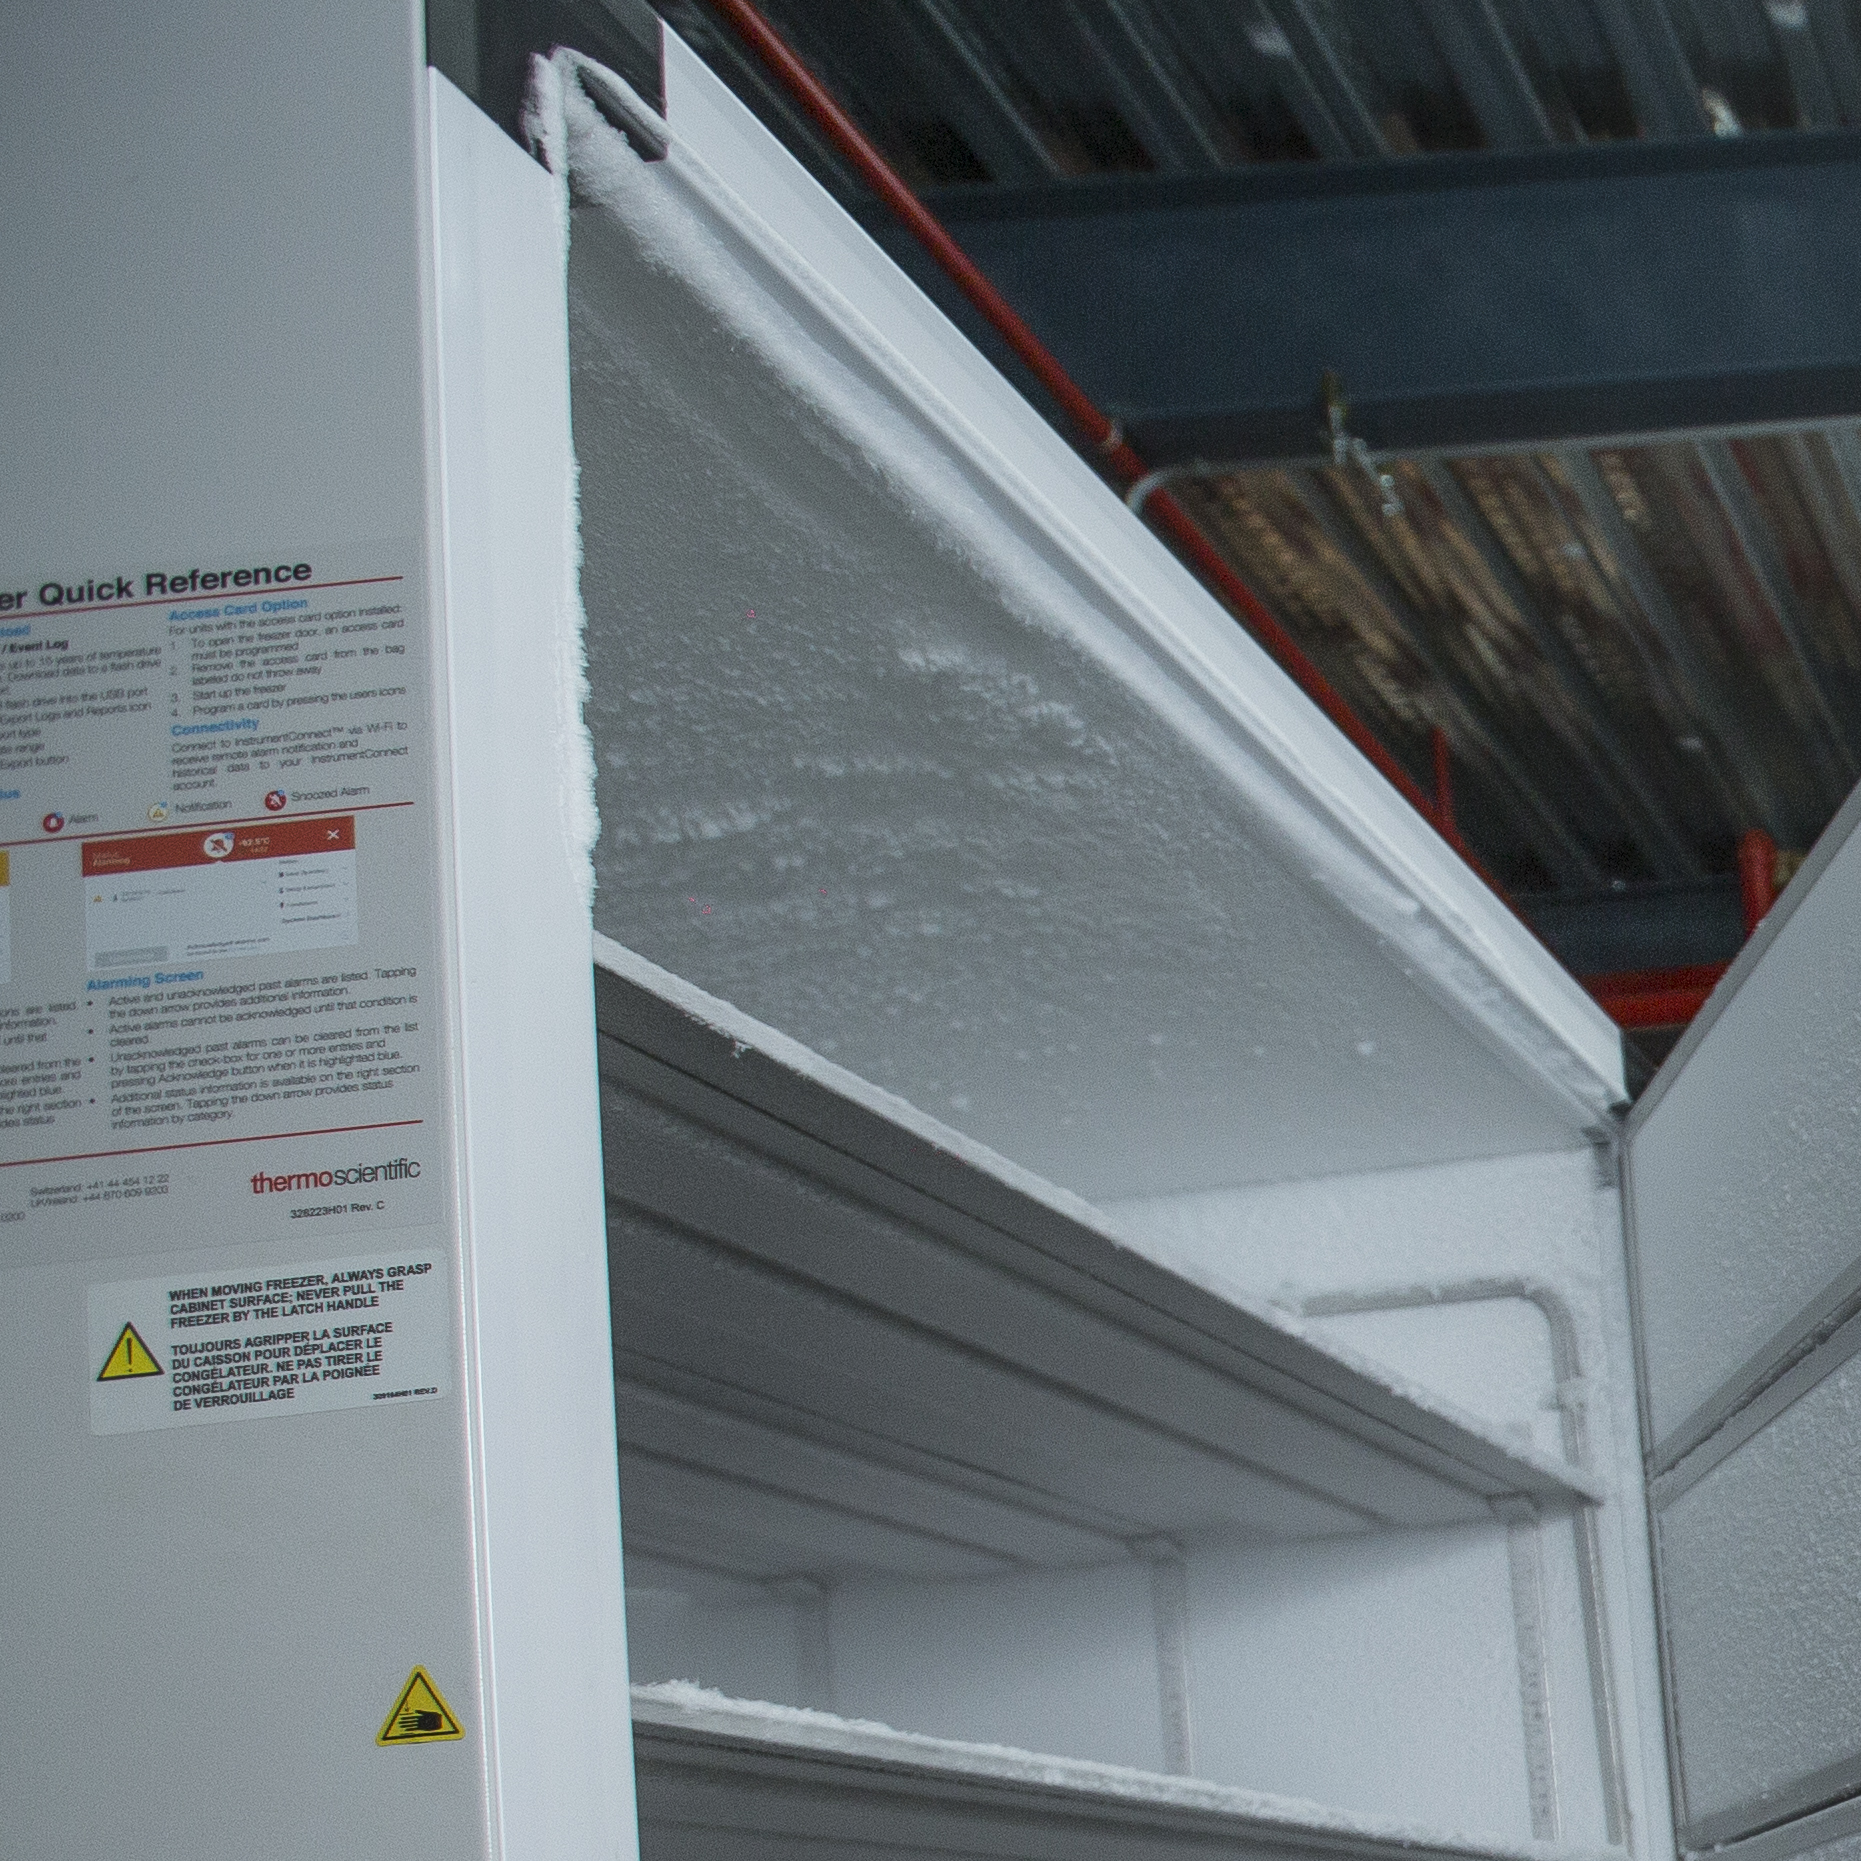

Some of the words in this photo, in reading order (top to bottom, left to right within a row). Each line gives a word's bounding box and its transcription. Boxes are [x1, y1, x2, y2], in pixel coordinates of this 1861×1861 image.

[38, 577, 133, 606] Quick
[144, 563, 312, 594] Reference
[168, 608, 220, 621] Access
[223, 604, 257, 616] Card
[261, 600, 308, 612] Option
[168, 625, 186, 636] For
[188, 623, 214, 634] units
[215, 621, 237, 631] with
[238, 619, 256, 629] the
[258, 616, 296, 627] access
[298, 613, 322, 623] card
[324, 610, 356, 620] option
[8, 642, 43, 653] Event
[46, 640, 69, 650] Log
[191, 637, 206, 648] To
[207, 637, 235, 648] open
[237, 634, 254, 643] the
[257, 631, 291, 641] freezer
[325, 626, 338, 635] an
[341, 623, 377, 633] access
[381, 619, 404, 629] card
[191, 650, 217, 660] must
[218, 649, 233, 658] be
[235, 643, 299, 657] programmed
[191, 662, 234, 673] Remove
[238, 659, 256, 668] the
[261, 656, 298, 666] access
[305, 652, 328, 662] card
[333, 649, 356, 658] from
[362, 647, 379, 655] the
[385, 645, 405, 654] bag
[191, 675, 229, 686] labeled
[231, 673, 245, 682] do
[246, 670, 263, 679] not
[265, 669, 293, 678] throw
[296, 666, 321, 675] away
[192, 690, 216, 701] Start
[218, 689, 233, 699] up
[234, 687, 251, 696] the
[253, 684, 286, 694] freezer
[192, 704, 236, 716] Program
[237, 703, 245, 711] a
[246, 699, 270, 710] card
[270, 698, 284, 708] by
[286, 695, 329, 707] pressing
[330, 692, 348, 701] the
[379, 687, 405, 696] icons
[170, 719, 259, 736] Connectivity
[170, 741, 216, 753] Connect
[219, 739, 232, 748] to
[348, 726, 363, 735] via
[366, 722, 392, 732] Wi-Fi
[397, 722, 407, 730] to
[171, 755, 210, 766] receive
[211, 751, 248, 761] remote
[250, 748, 279, 758] alarm
[281, 742, 336, 754] notification
[339, 739, 358, 749] and
[171, 766, 217, 778] historical
[226, 763, 250, 773] data
[258, 761, 270, 770] to
[279, 758, 301, 768] your
[311, 747, 408, 763] InstrumentConnect
[174, 801, 231, 813] Notification
[290, 790, 338, 802] Snoozed
[340, 787, 369, 796] Alarm
[86, 977, 151, 990] Alarming
[154, 971, 203, 984] Screen
[108, 995, 142, 1006] Active
[142, 992, 164, 1003] and
[166, 984, 256, 1000] unacknowledged
[258, 981, 281, 991] past
[284, 978, 319, 988] alarms
[321, 975, 338, 984] are
[375, 968, 416, 978] Tapping
[108, 1009, 127, 1019] the
[128, 1007, 159, 1017] down
[159, 1004, 191, 1014] arrow
[192, 999, 237, 1011] provides
[240, 993, 288, 1005] additional
[108, 1023, 142, 1034] Active
[143, 1020, 178, 1031] alarms
[180, 1015, 217, 1027] cannot
[218, 1014, 234, 1023] be
[235, 1006, 312, 1021] acknowledged
[314, 1003, 335, 1013] until
[337, 1001, 356, 1010] that
[359, 997, 407, 1008] condition
[408, 995, 417, 1003] is
[251, 1158, 420, 1193] thermoscientific
[350, 1203, 373, 1212] Rev.
[376, 1200, 385, 1210] C
[168, 1288, 208, 1301] WHEN
[210, 1282, 263, 1296] MOVING
[265, 1275, 328, 1290] FREEZER,
[331, 1269, 384, 1283] ALWAYS
[387, 1263, 432, 1277] GRASP
[169, 1299, 226, 1314] CABINET
[296, 1287, 339, 1301] NEVER
[342, 1284, 375, 1295] PULL
[378, 1279, 403, 1291] THE
[170, 1313, 230, 1328] FREEZER
[232, 1310, 250, 1322] BY
[253, 1307, 278, 1319] THE
[281, 1303, 324, 1316] LATCH
[326, 1296, 378, 1311] HANDLE
[170, 1339, 241, 1355] TOUJOURS
[244, 1331, 310, 1347] AGRIPPER
[312, 1329, 330, 1341] LA
[332, 1322, 392, 1338] SURFACE
[171, 1358, 190, 1370] DU
[193, 1352, 251, 1367] CAISSON
[253, 1347, 290, 1360] POUR
[293, 1339, 362, 1356] DÉPLACER
[365, 1337, 382, 1349] LE
[275, 1360, 293, 1372] NE
[296, 1357, 322, 1369] PAS
[325, 1353, 363, 1366] TIRER
[366, 1350, 382, 1365] LE
[172, 1377, 269, 1396] CONGÉLATEUR
[272, 1373, 299, 1385] PAR
[302, 1372, 319, 1383] LA
[322, 1365, 379, 1380] POIGNÉE
[172, 1399, 191, 1411] DE
[193, 1388, 294, 1408] VERROUILLAGE
